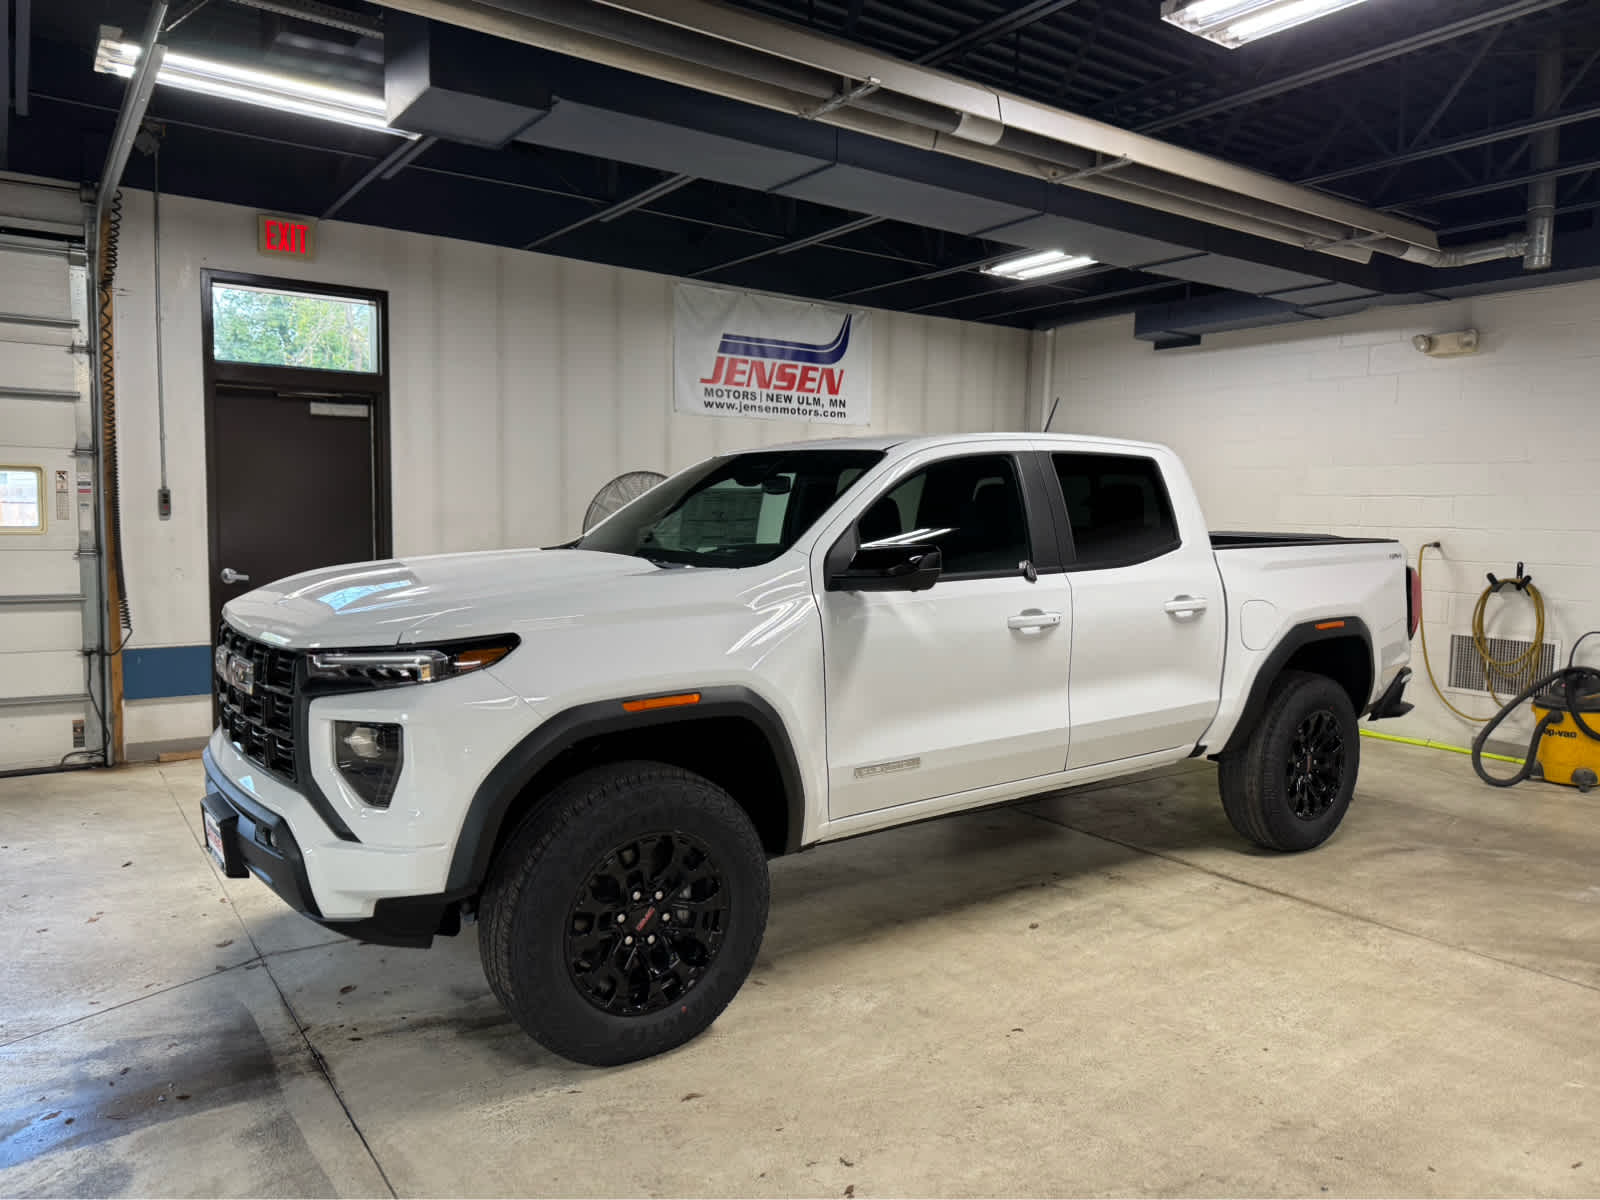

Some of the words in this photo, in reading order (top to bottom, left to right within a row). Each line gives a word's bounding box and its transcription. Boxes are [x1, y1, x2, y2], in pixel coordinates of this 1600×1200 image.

[265, 220, 308, 254] EXIT
[700, 356, 844, 395] JENSEN
[704, 387, 757, 401] MOTORS
[765, 393, 793, 404] NEW
[797, 396, 825, 408] ULM,
[829, 398, 846, 409] MN
[704, 400, 847, 418] www.jensenmotors.com
